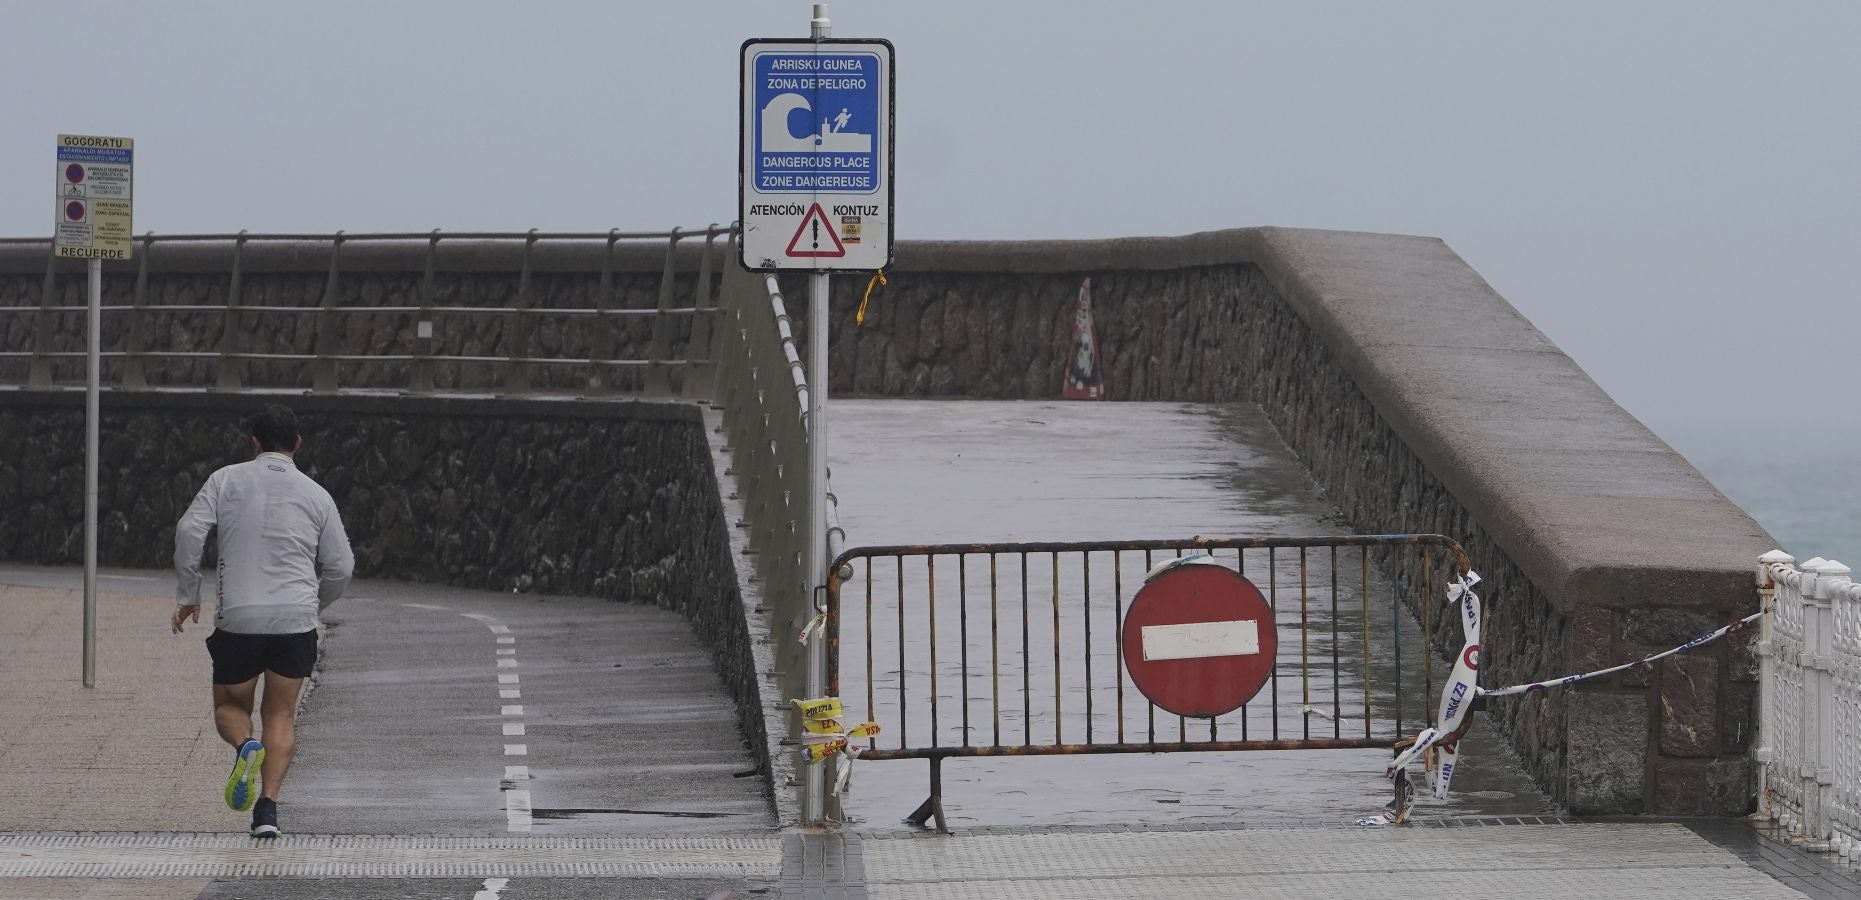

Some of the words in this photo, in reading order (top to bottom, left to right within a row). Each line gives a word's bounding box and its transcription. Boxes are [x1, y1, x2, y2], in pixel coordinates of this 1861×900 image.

[772, 59, 820, 70] ARRISKU
[823, 59, 862, 70] GUNEA
[767, 79, 799, 90] ZONA
[800, 79, 816, 90] DE
[818, 79, 866, 90] PELIGRO
[64, 136, 123, 148] GOGORATU
[763, 157, 832, 168] DANGEROUS
[834, 157, 870, 168] PLACE
[762, 176, 792, 187] ZONE
[795, 176, 870, 187] DANGEREUSE
[749, 202, 805, 216] ATENCIÓN
[833, 205, 878, 217] KONTUZ
[61, 247, 124, 259] RECUERDE
[1453, 681, 1468, 699] EZ
